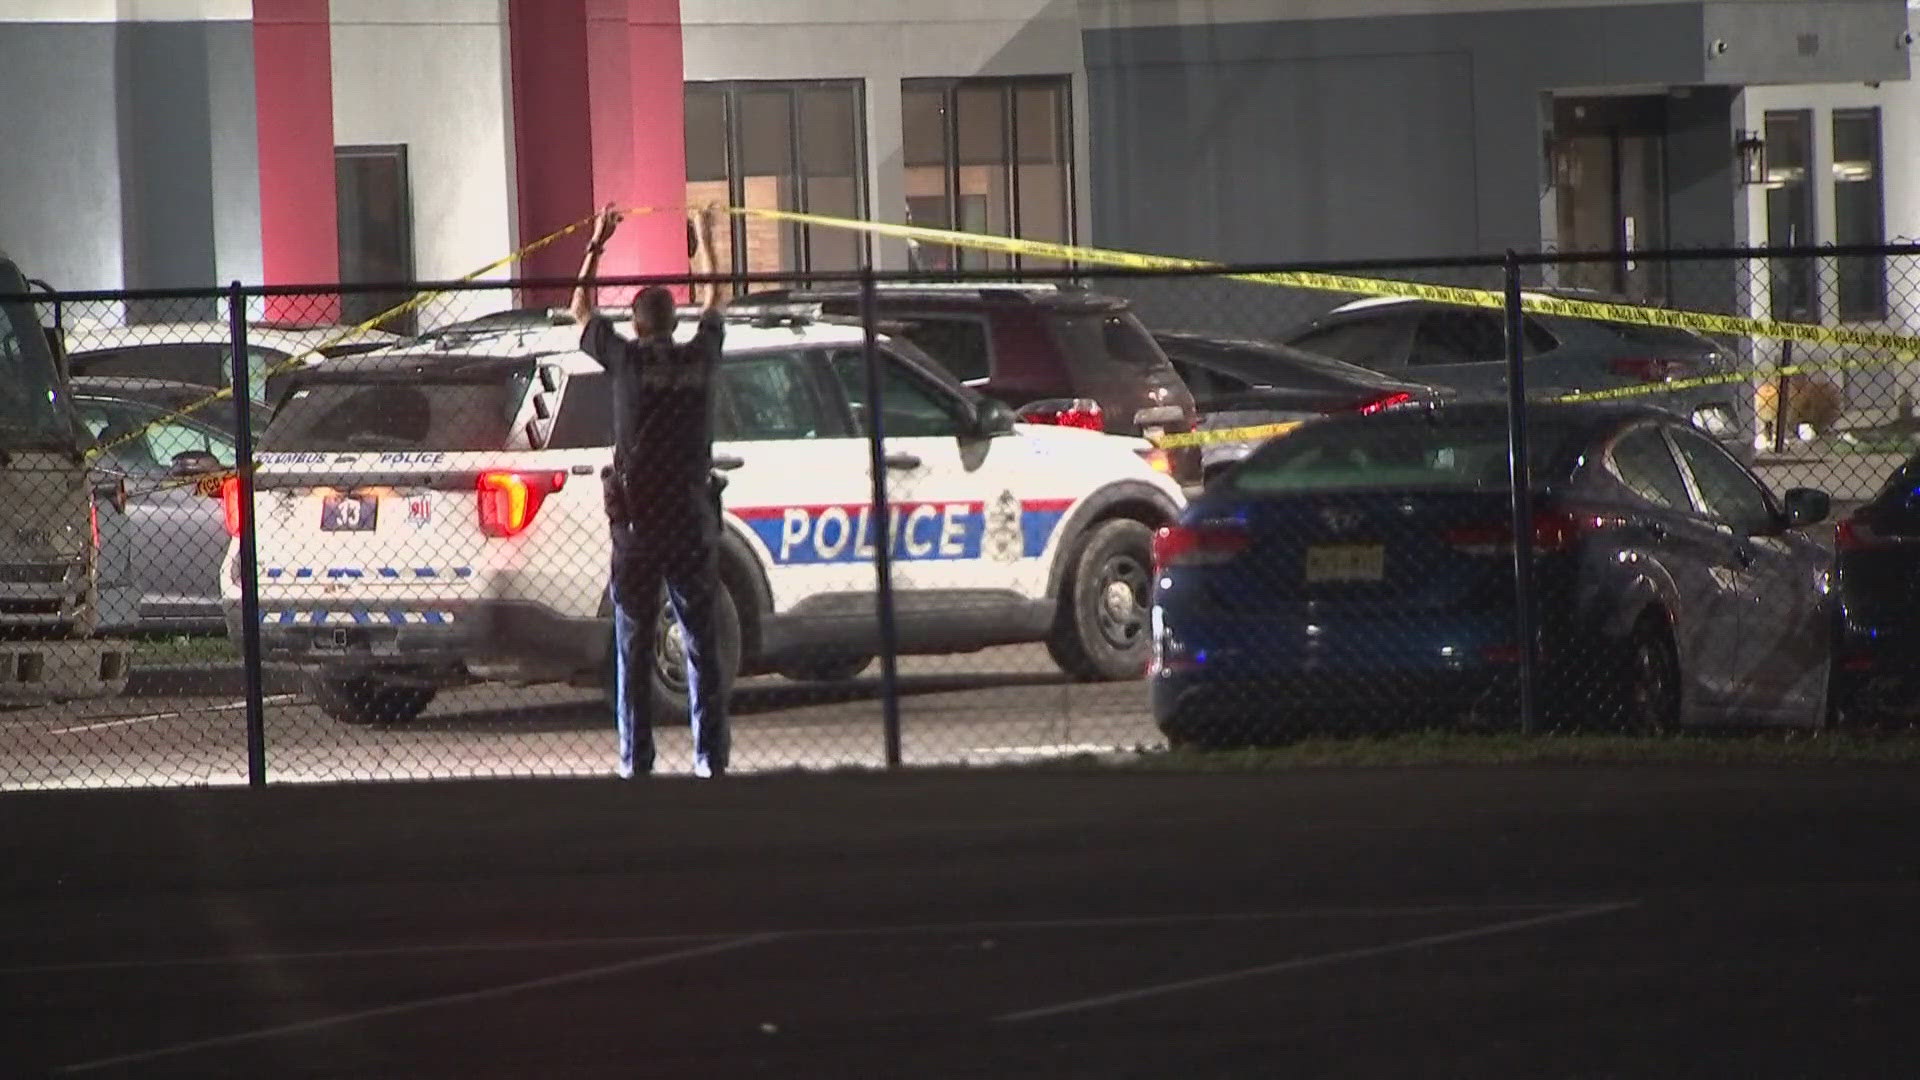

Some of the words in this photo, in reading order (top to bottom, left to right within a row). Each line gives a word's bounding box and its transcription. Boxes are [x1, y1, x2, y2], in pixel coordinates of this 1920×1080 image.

[380, 453, 445, 464] POLICE
[336, 499, 361, 526] 33
[411, 501, 430, 518] 911
[780, 503, 971, 561] POLICE
